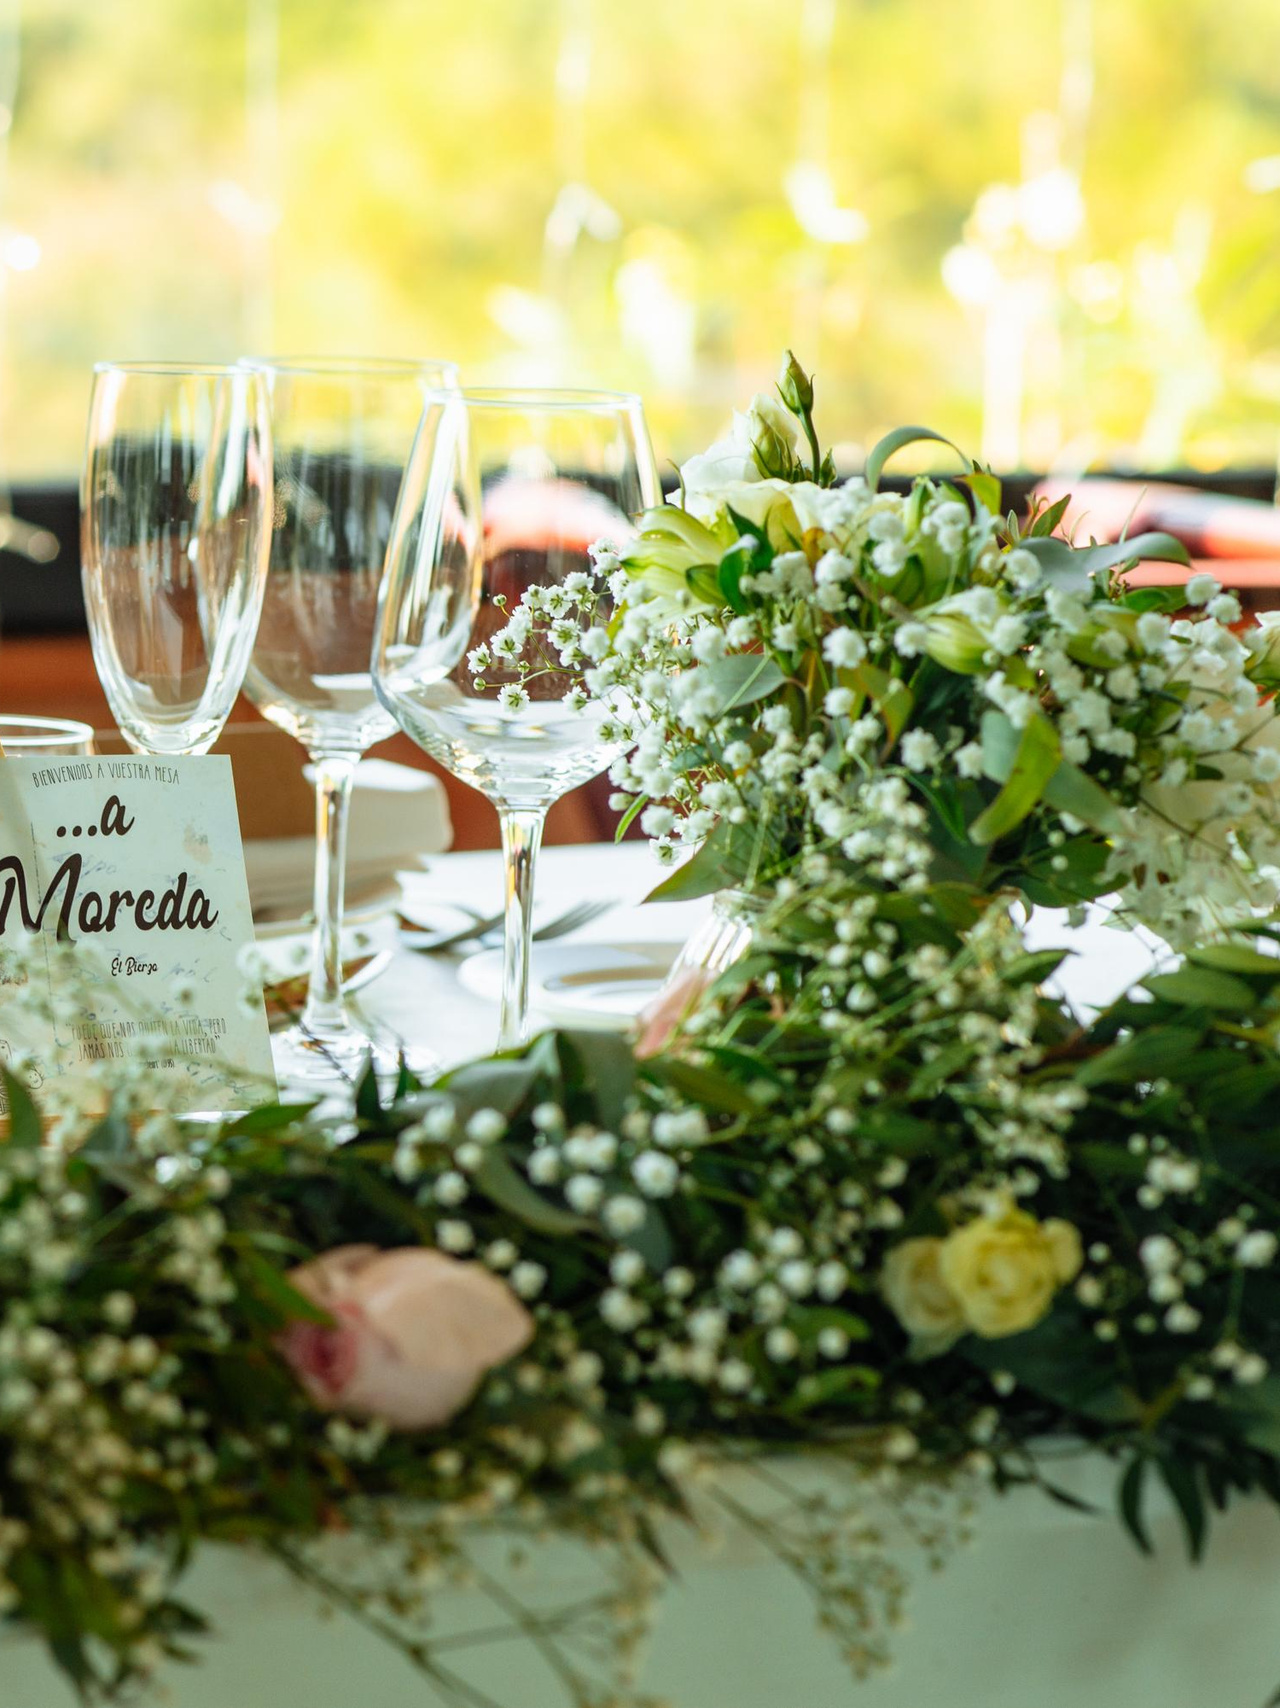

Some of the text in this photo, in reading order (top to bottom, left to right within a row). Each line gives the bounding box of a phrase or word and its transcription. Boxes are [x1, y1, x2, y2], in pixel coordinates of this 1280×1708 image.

[32, 762, 180, 788] BIENVENIDOS A VUESTRA MESA
[56, 795, 135, 837] ...a
[111, 956, 158, 977] El Bierzo
[107, 1041, 124, 1058] NOS
